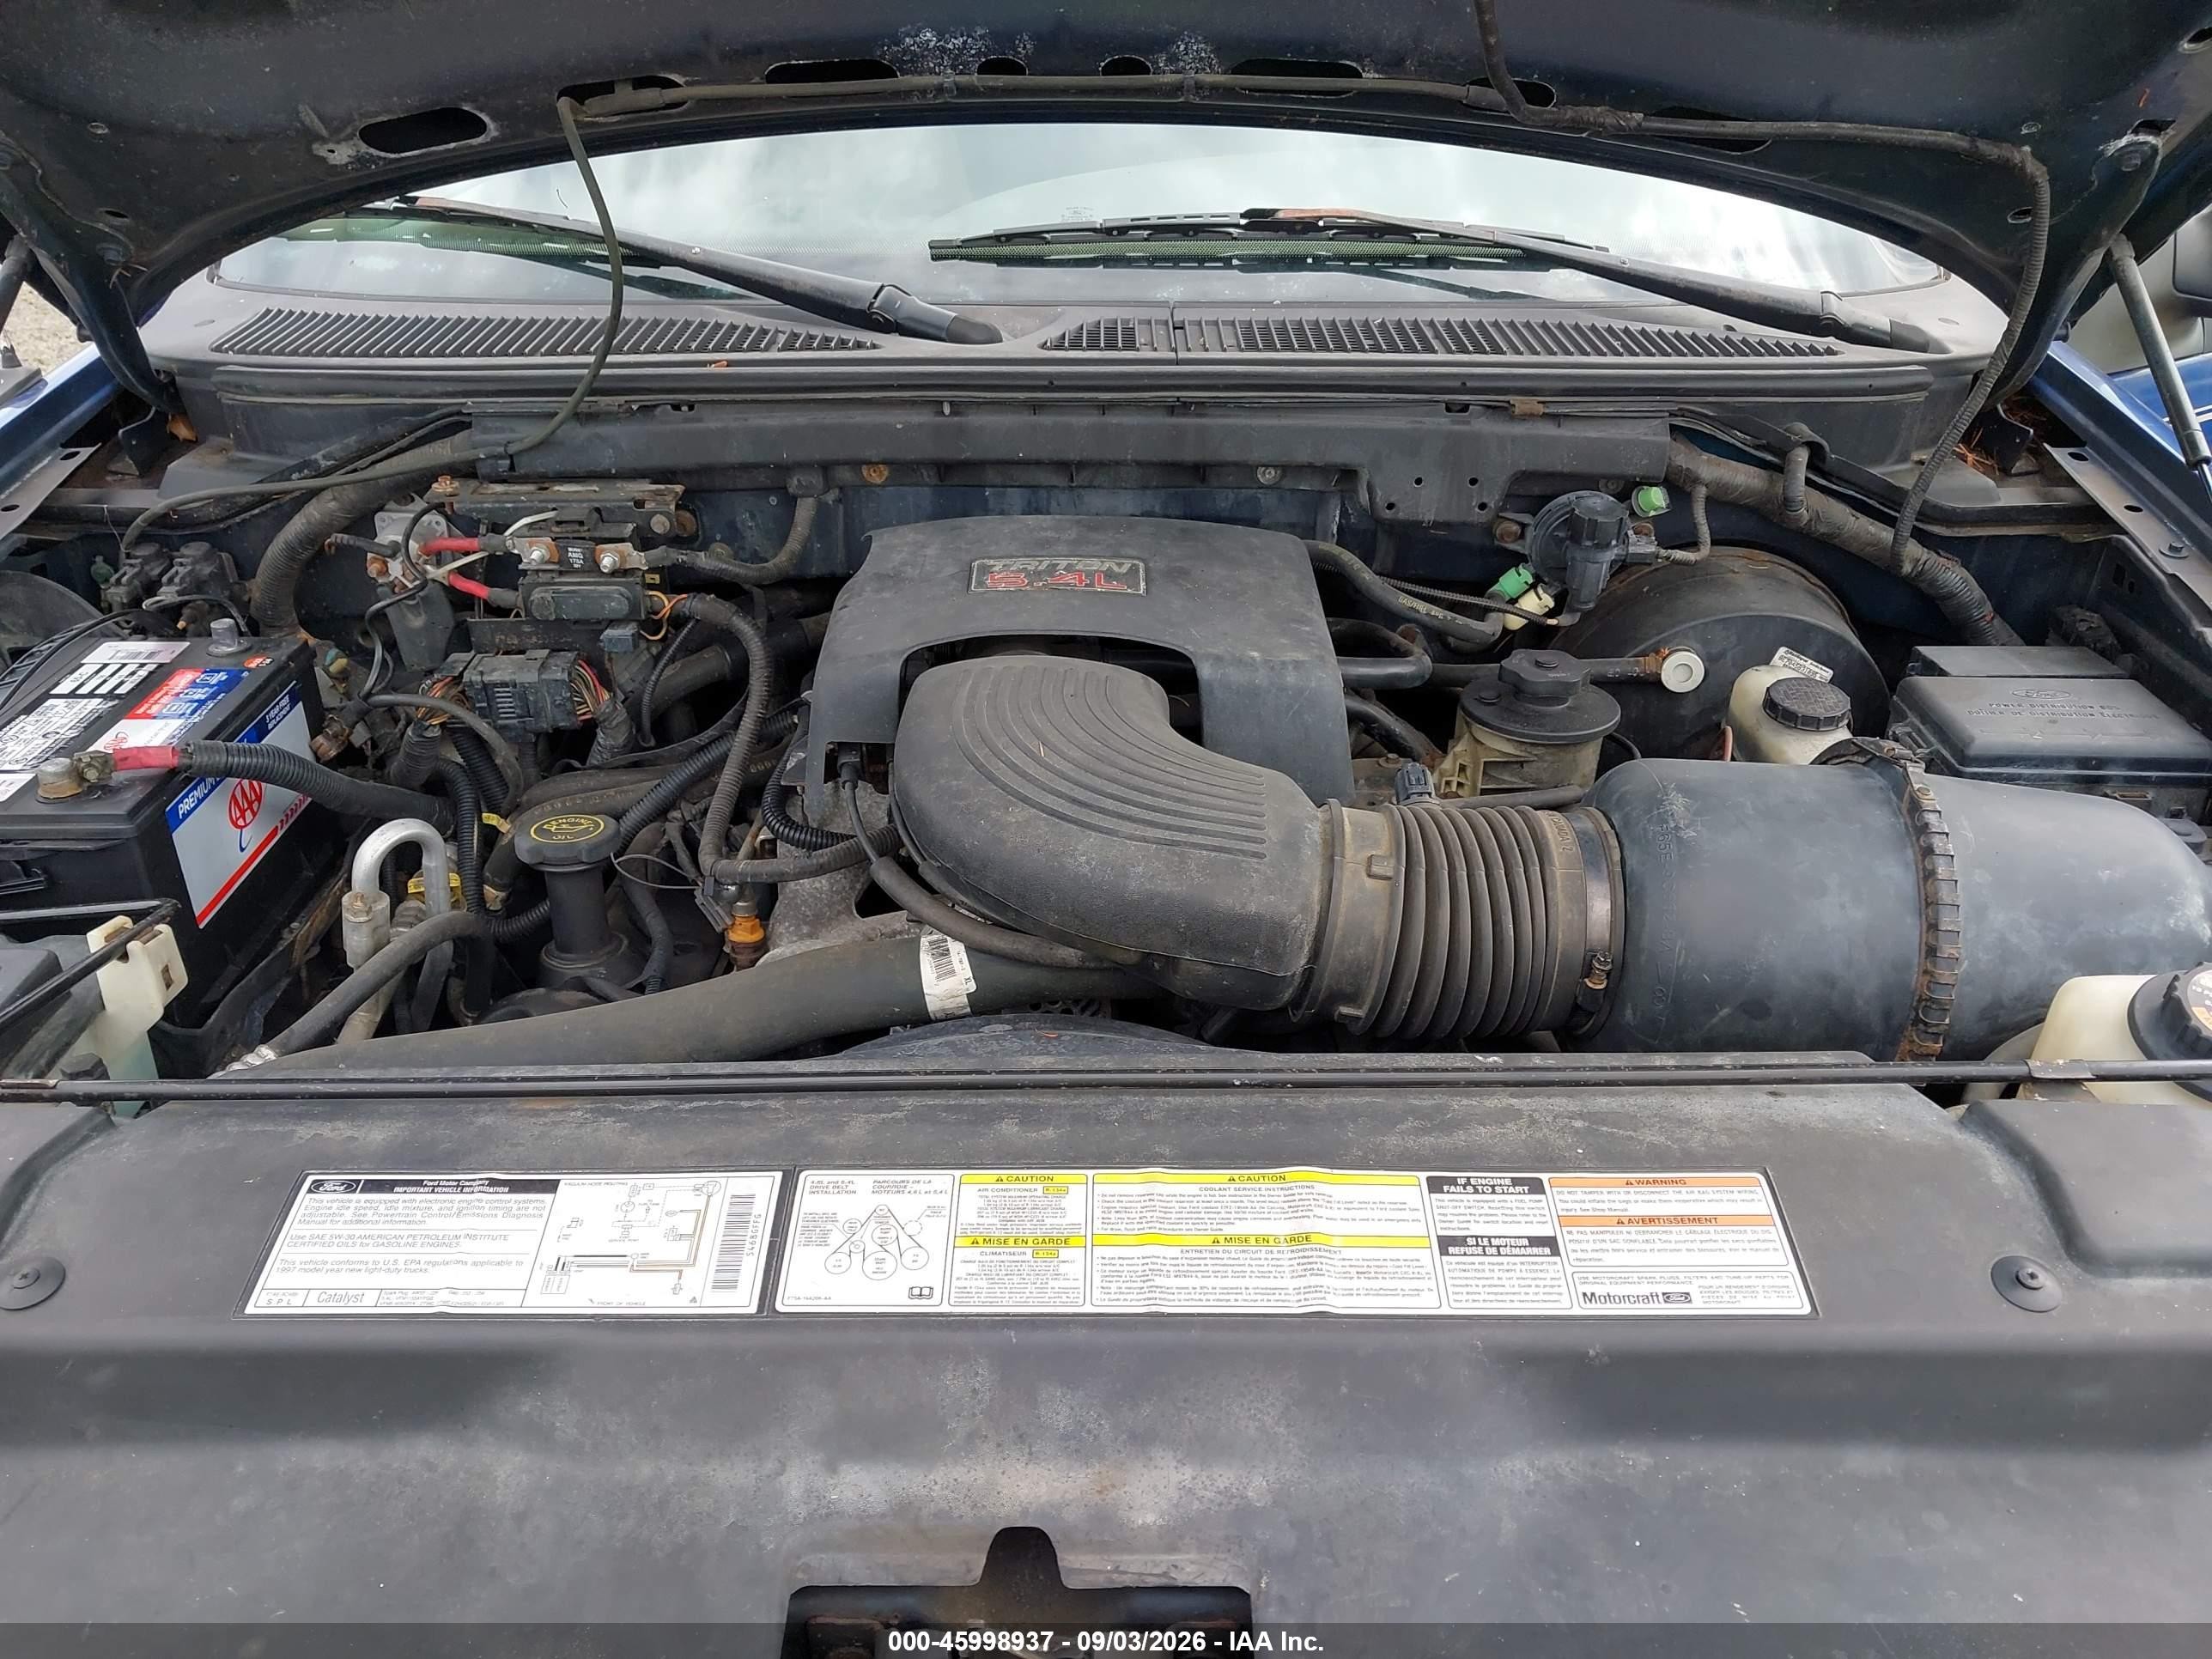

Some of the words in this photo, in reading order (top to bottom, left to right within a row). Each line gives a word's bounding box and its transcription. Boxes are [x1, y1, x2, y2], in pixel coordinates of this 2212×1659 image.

[989, 559, 1132, 573] TRITON
[987, 570, 1127, 590] 5.4L
[1273, 1235, 1312, 1244] GARDE
[1491, 1237, 1528, 1246] MOTEUR
[318, 1291, 364, 1305] Catalyst
[1582, 1291, 1662, 1304] Motorcraft
